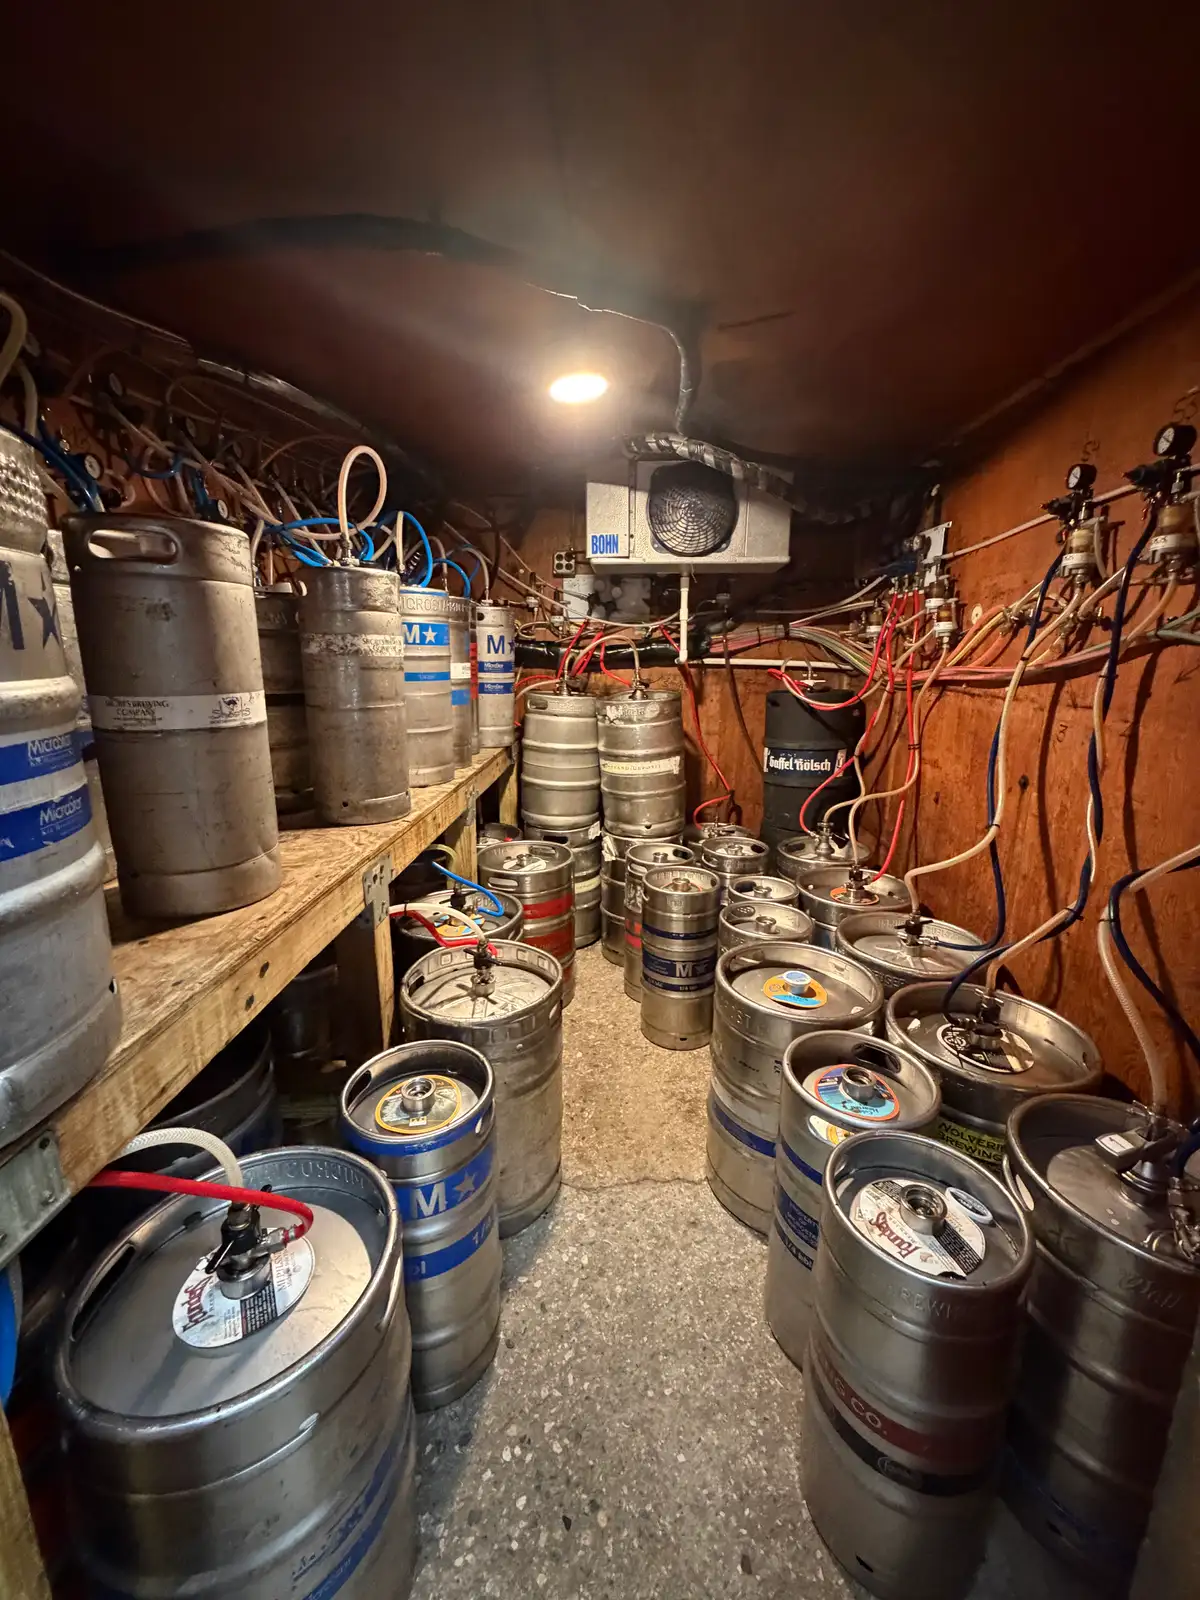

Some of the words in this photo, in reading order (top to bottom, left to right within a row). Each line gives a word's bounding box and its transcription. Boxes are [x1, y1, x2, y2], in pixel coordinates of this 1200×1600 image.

[591, 534, 619, 555] BOHN
[487, 634, 505, 655] M
[769, 755, 794, 772] Gaffel
[794, 757, 831, 772] Kölsch
[675, 961, 693, 978] M
[411, 1181, 447, 1219] M
